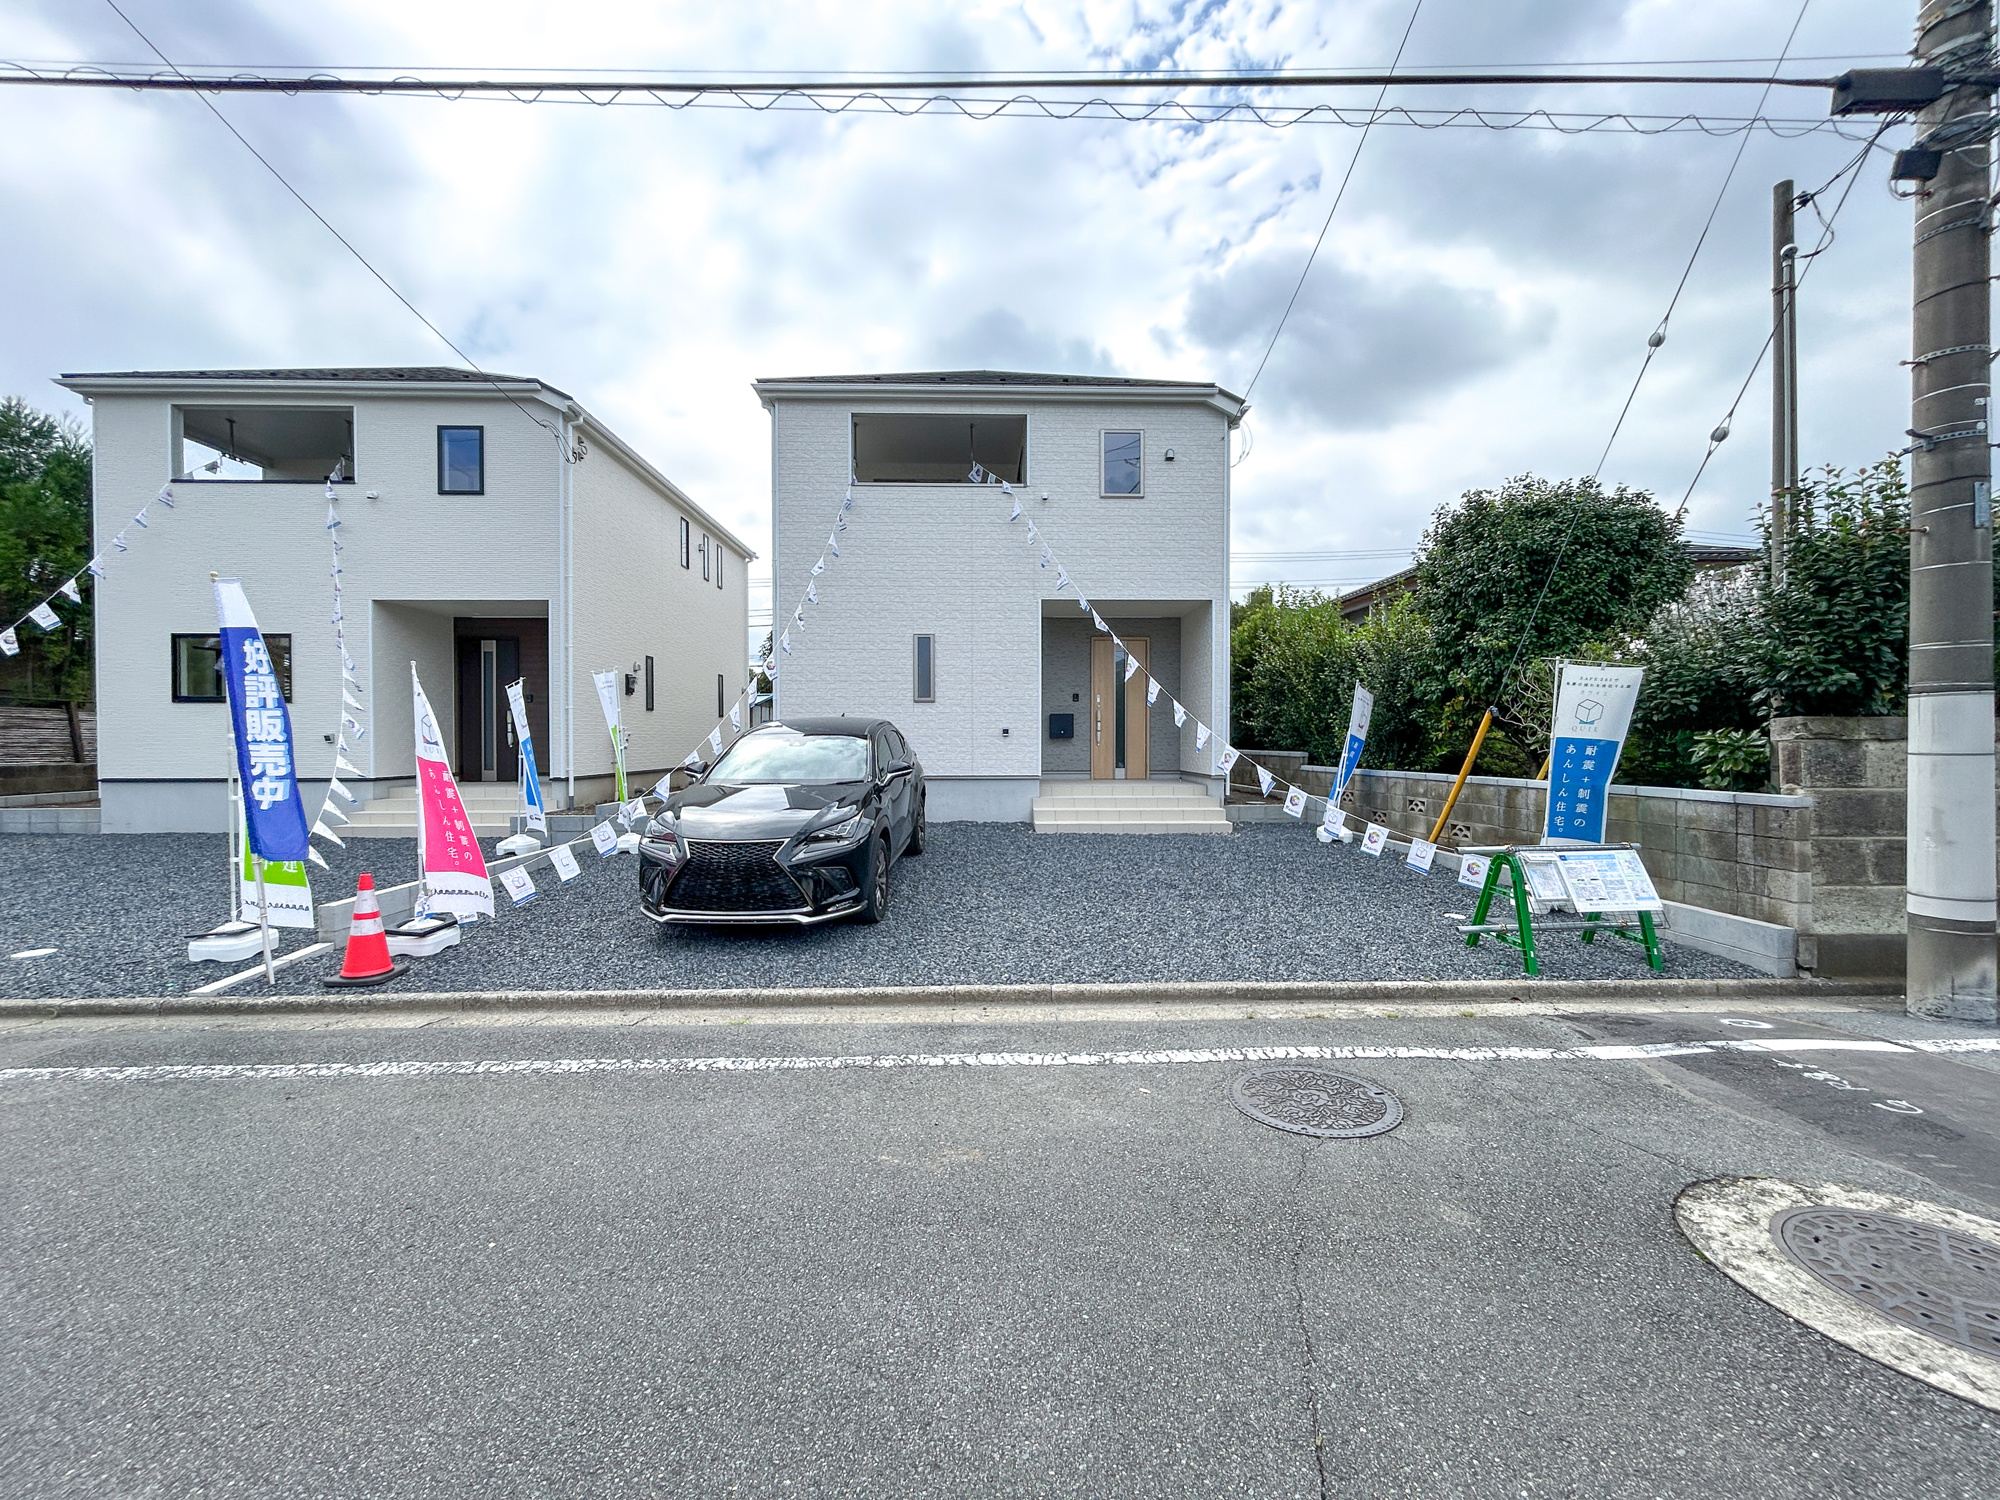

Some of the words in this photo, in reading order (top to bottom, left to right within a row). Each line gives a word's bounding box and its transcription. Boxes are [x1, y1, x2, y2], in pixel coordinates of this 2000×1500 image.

[243, 637, 291, 811] 好評販売中
[1553, 743, 1577, 833] あんしん住宅。
